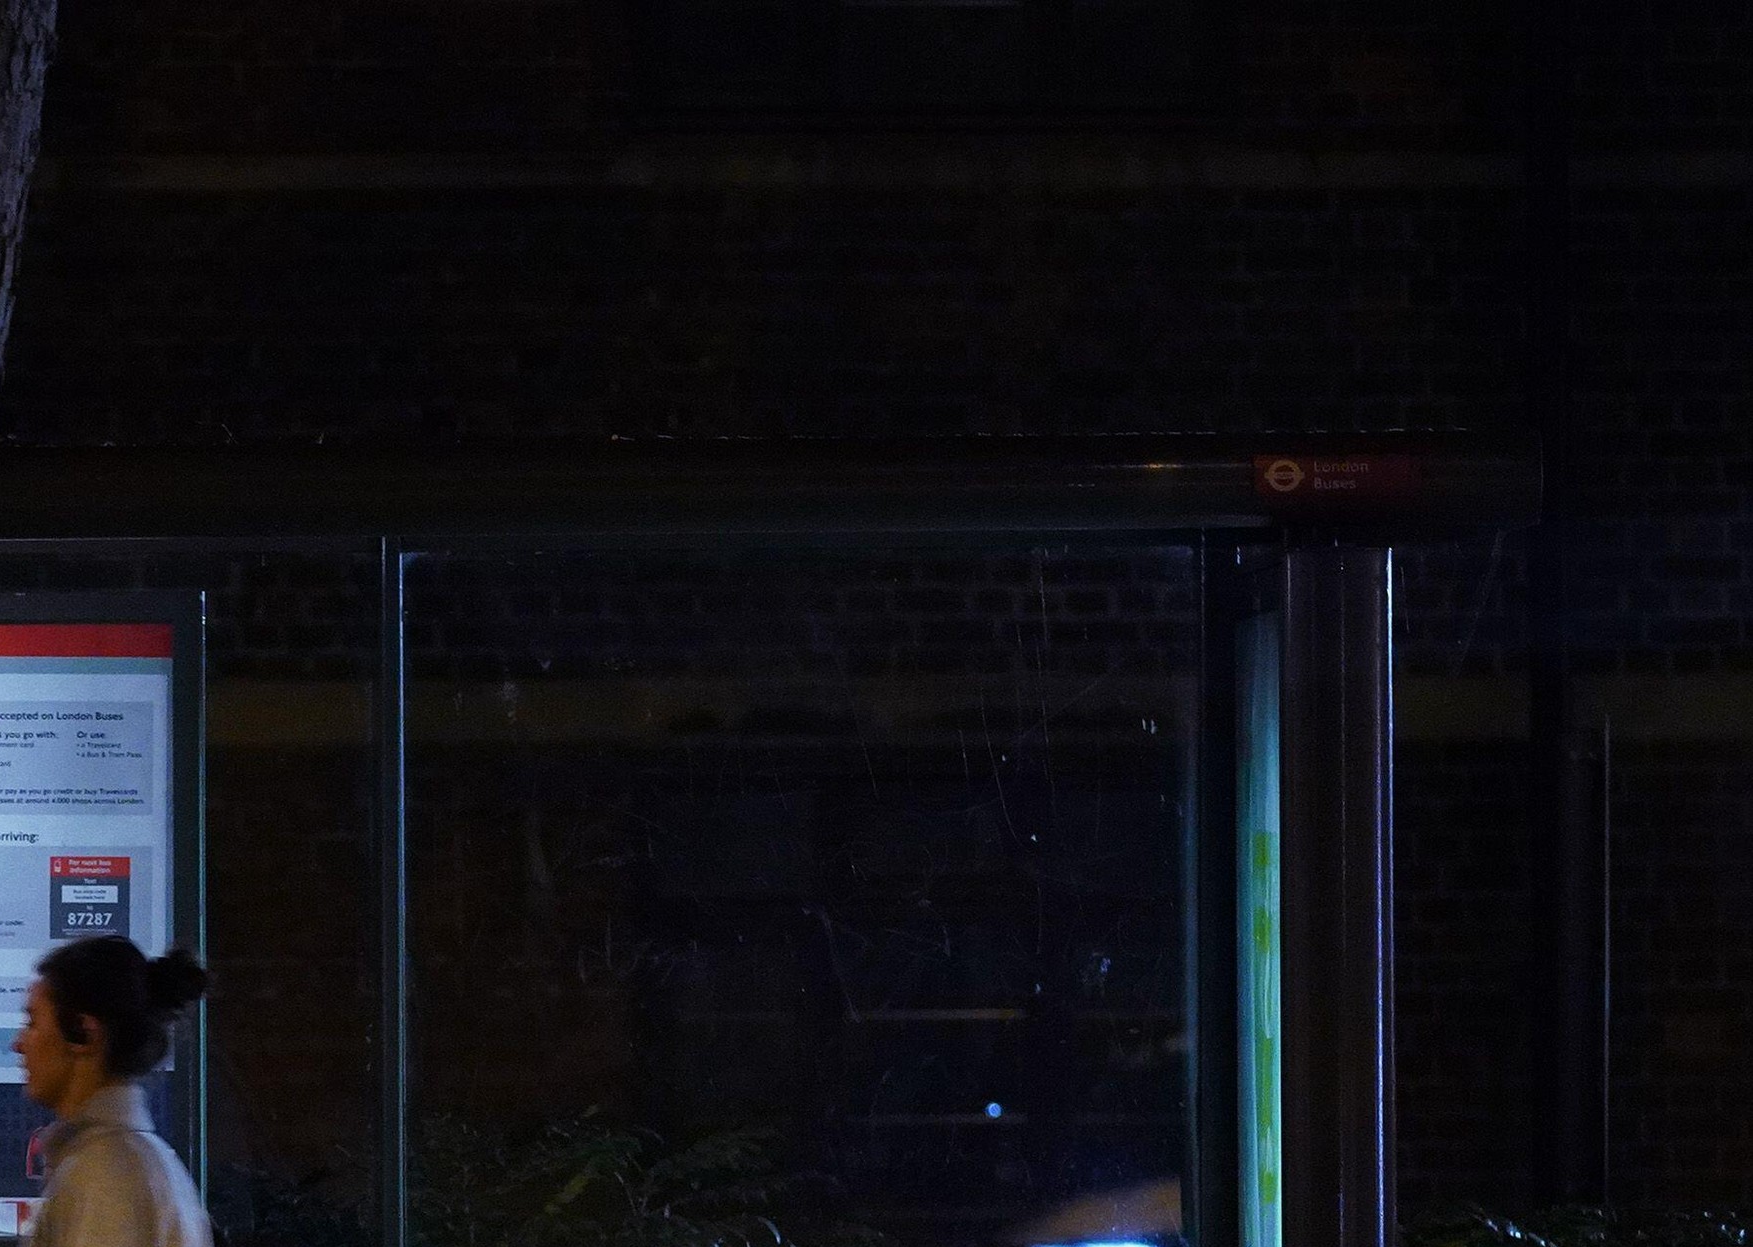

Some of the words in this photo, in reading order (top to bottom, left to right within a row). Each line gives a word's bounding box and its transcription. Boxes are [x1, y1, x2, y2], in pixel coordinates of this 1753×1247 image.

[1313, 461, 1369, 473] London
[1313, 478, 1357, 490] Buses
[56, 712, 93, 720] London
[96, 712, 124, 721] Buses
[5, 732, 20, 740] you
[23, 732, 34, 740] go
[68, 913, 112, 925] 87287
